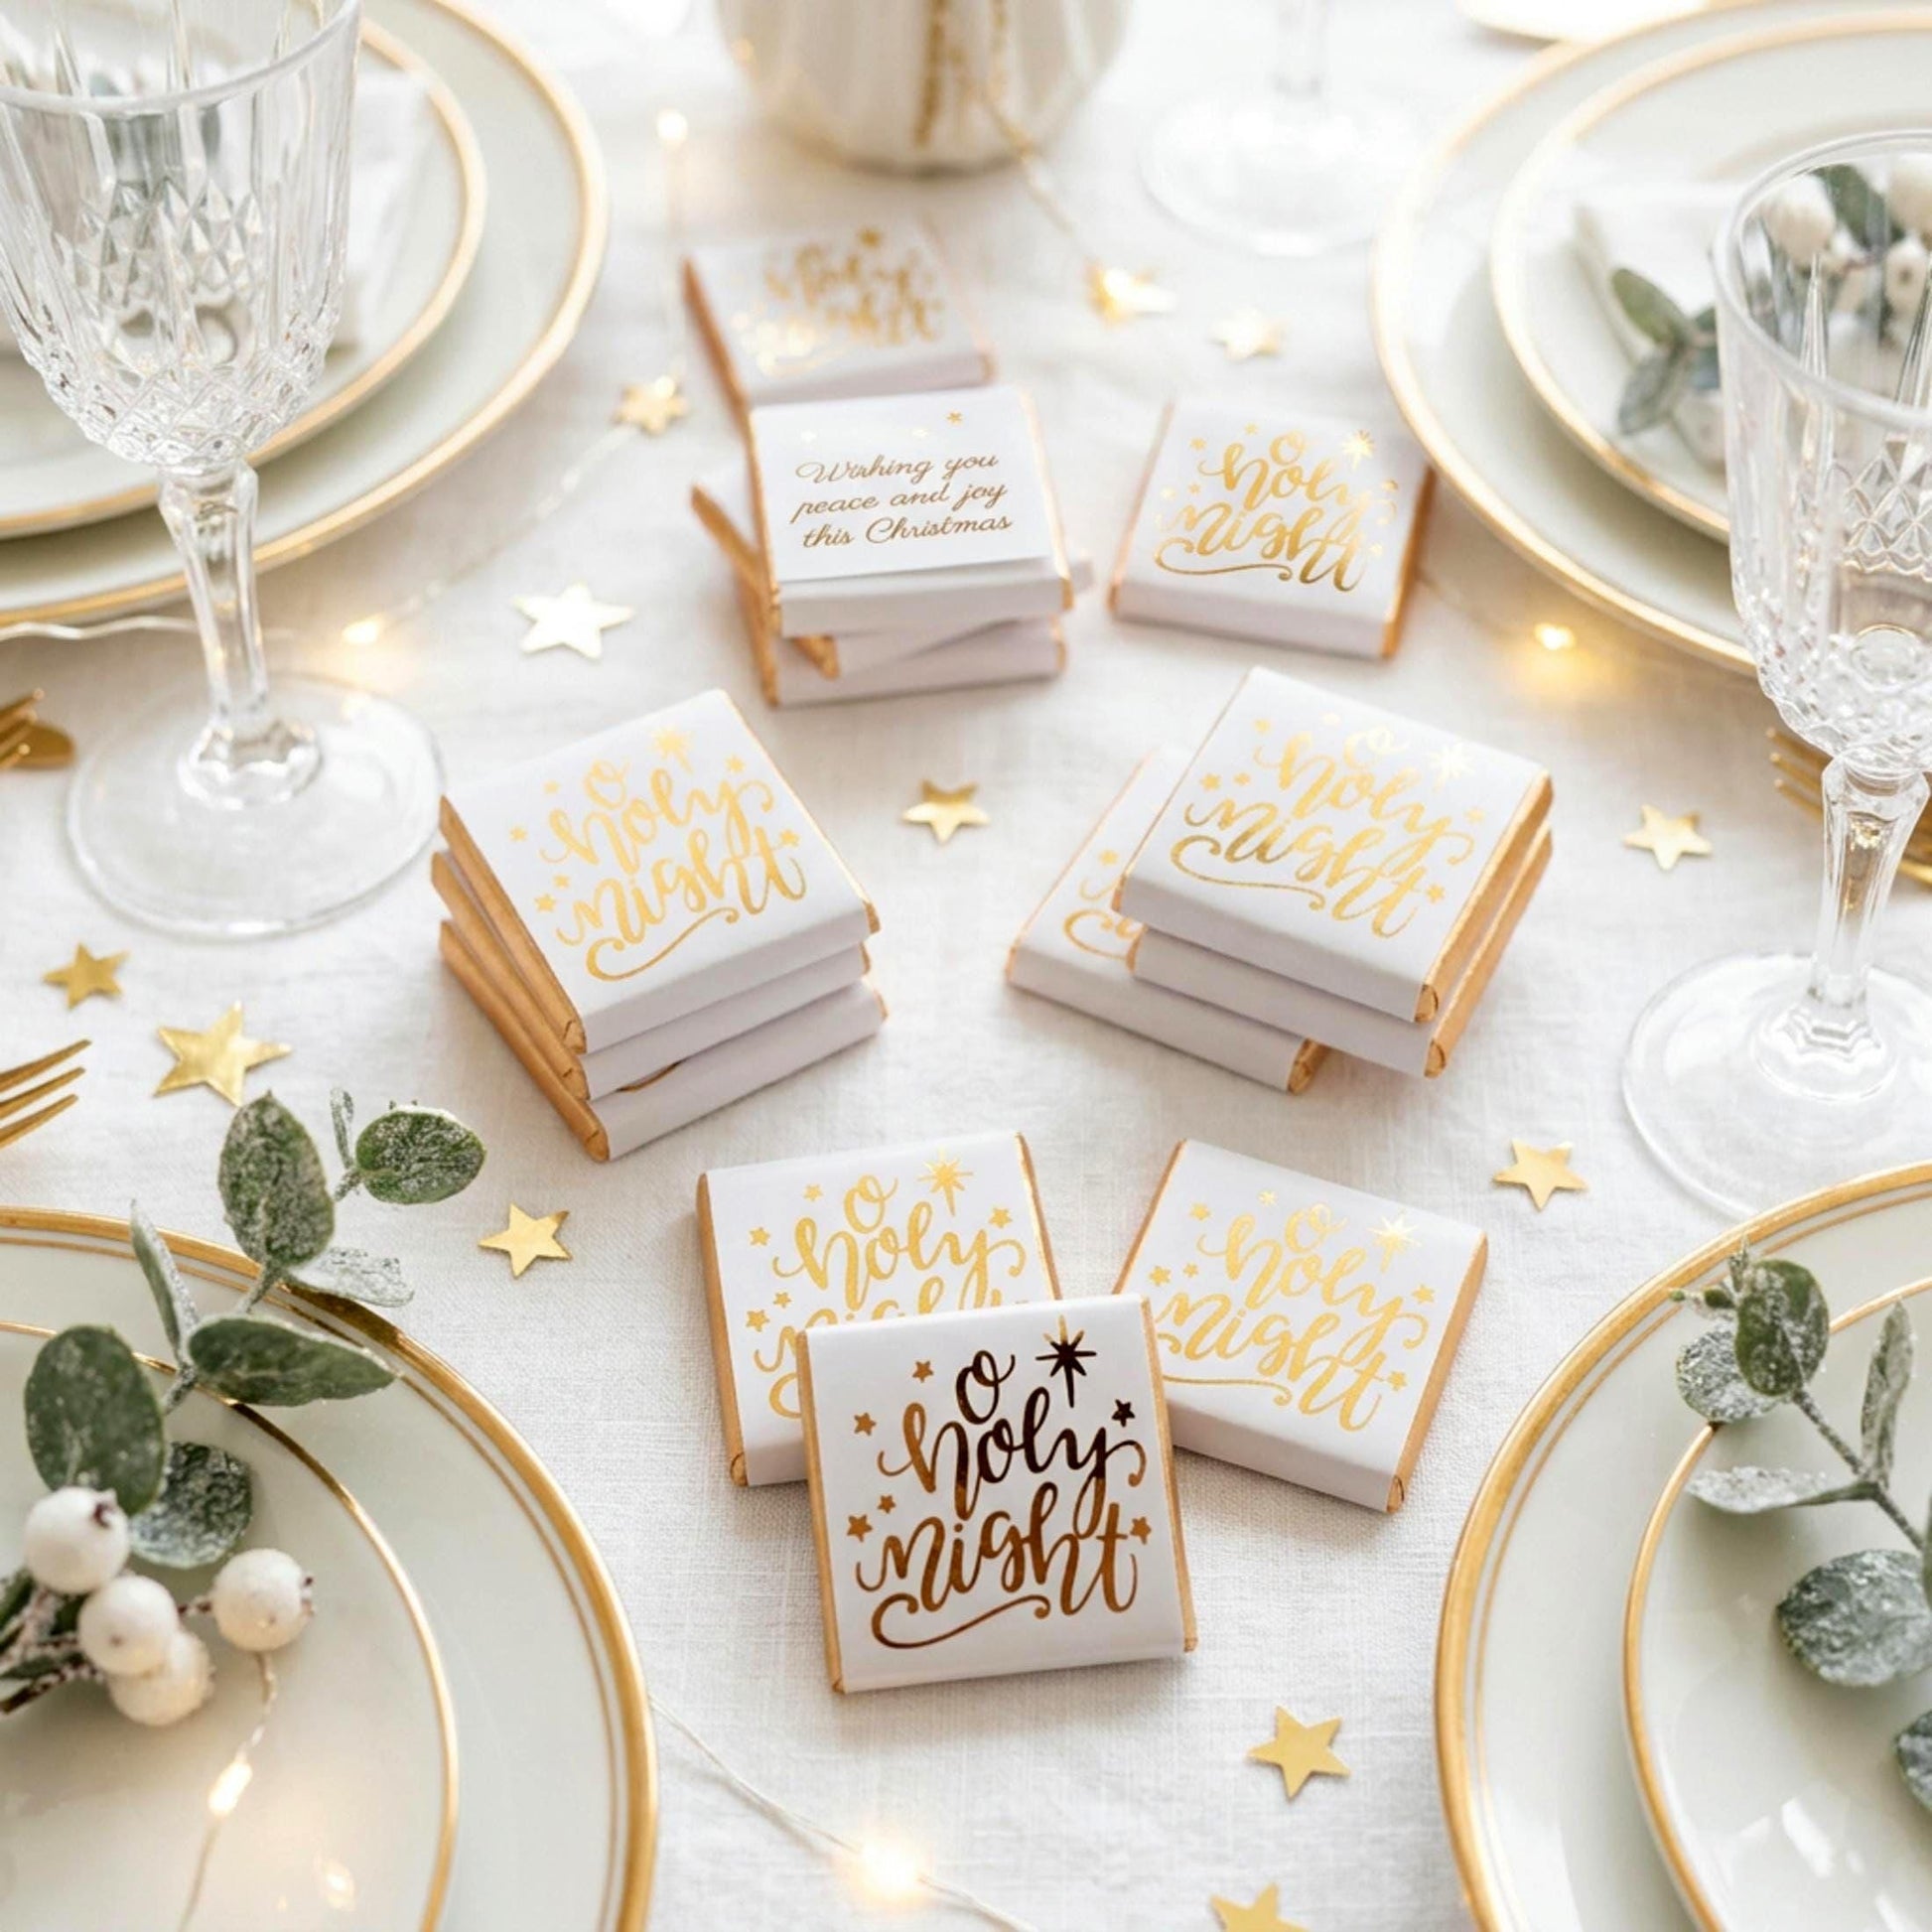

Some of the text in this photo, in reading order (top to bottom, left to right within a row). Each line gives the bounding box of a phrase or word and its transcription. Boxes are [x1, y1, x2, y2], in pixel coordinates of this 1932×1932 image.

[789, 482, 1009, 524] peace and joy
[795, 454, 1000, 484] Wishing you
[803, 514, 1014, 548] this Christmas
[1154, 502, 1367, 592] night
[539, 768, 774, 875] holy
[1253, 732, 1475, 878] holy
[556, 826, 807, 946] night
[1183, 798, 1419, 939] night
[771, 1201, 1028, 1312] holy
[1195, 1214, 1430, 1368] holy
[1154, 1291, 1383, 1433] night
[878, 1386, 1147, 1540] holy
[856, 1481, 1138, 1615] night
